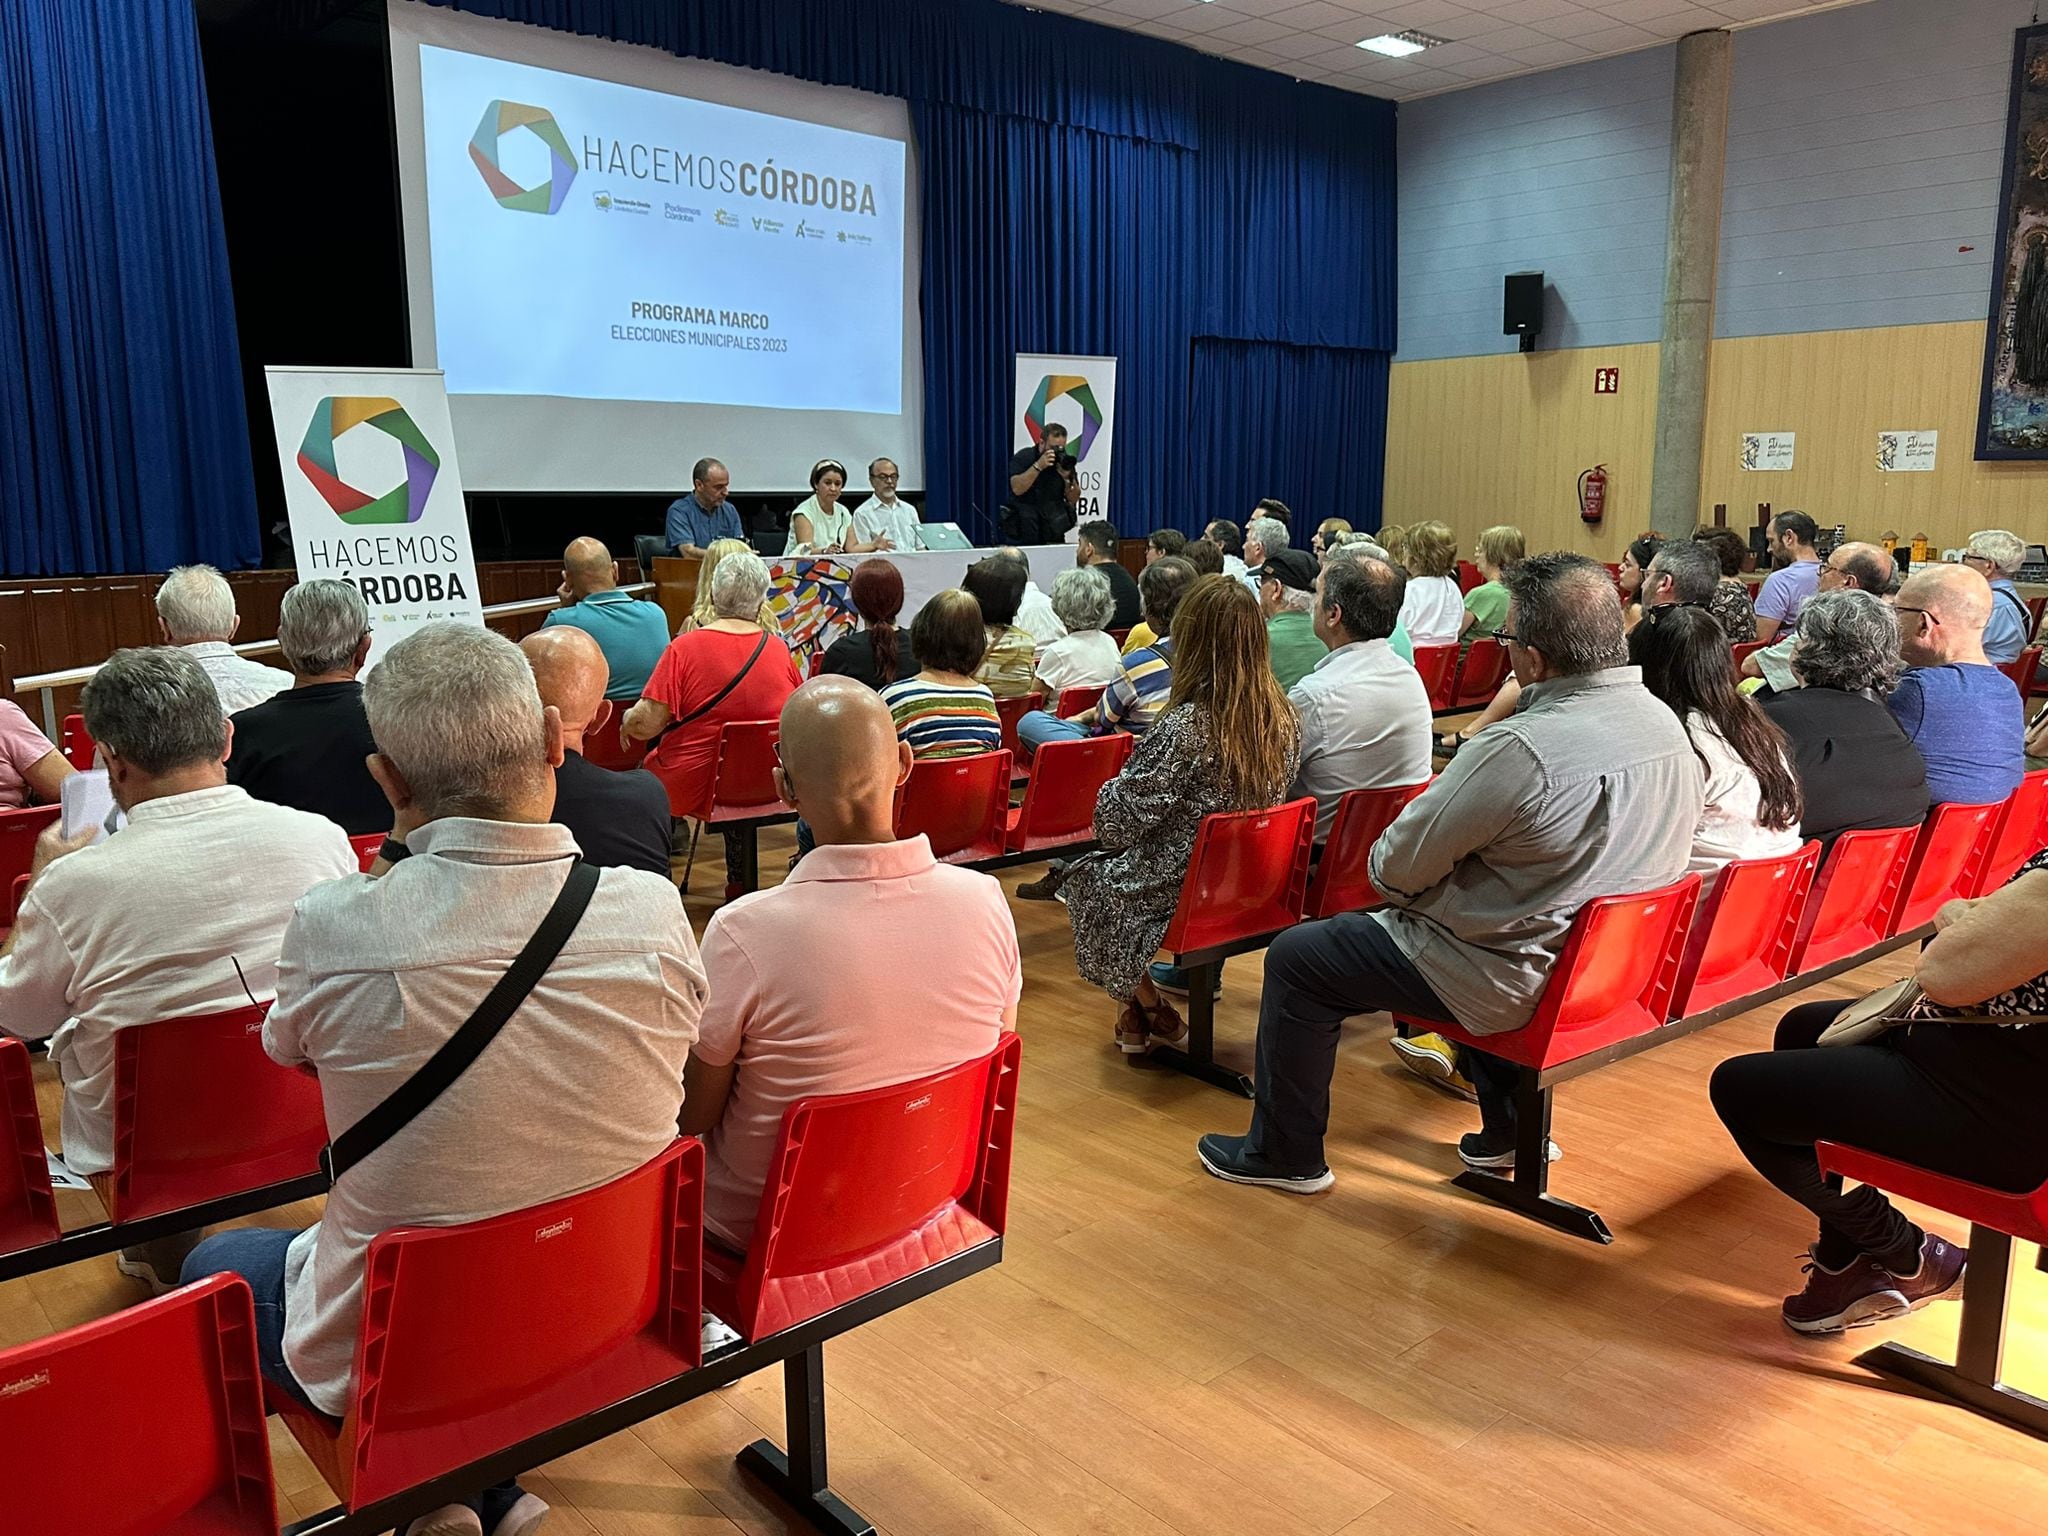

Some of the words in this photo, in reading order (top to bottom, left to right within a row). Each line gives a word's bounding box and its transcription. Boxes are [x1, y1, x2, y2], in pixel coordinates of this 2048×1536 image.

[664, 202, 701, 216] Podemos
[664, 211, 694, 223] Córdoba
[631, 302, 716, 326] PROGRAMA
[719, 310, 769, 330] MARCO
[611, 324, 686, 345] ELECCIONES
[688, 331, 761, 351] MUNICIPALES
[762, 337, 788, 353] 2023
[309, 535, 458, 569] HACEMOS
[340, 570, 467, 606] RDOBA
